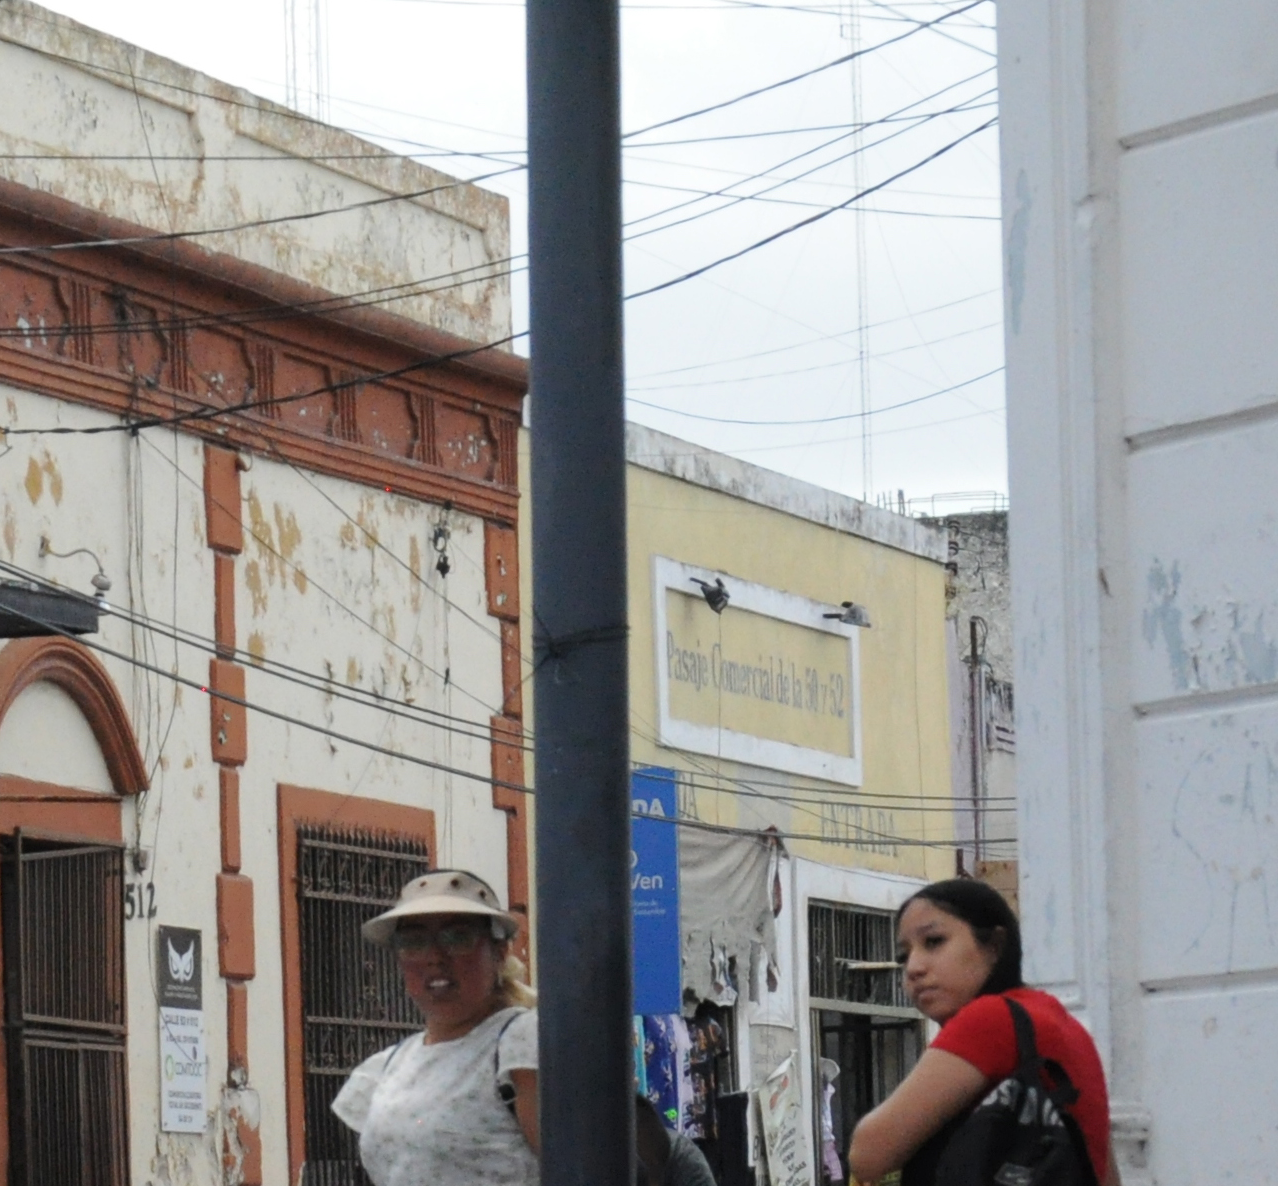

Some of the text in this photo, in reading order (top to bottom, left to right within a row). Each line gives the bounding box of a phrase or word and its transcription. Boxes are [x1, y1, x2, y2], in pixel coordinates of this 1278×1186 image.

[666, 630, 709, 692] Pasaje
[711, 642, 774, 702] Comercial
[776, 658, 790, 706] de
[791, 661, 803, 709] la
[124, 882, 158, 921] 512
